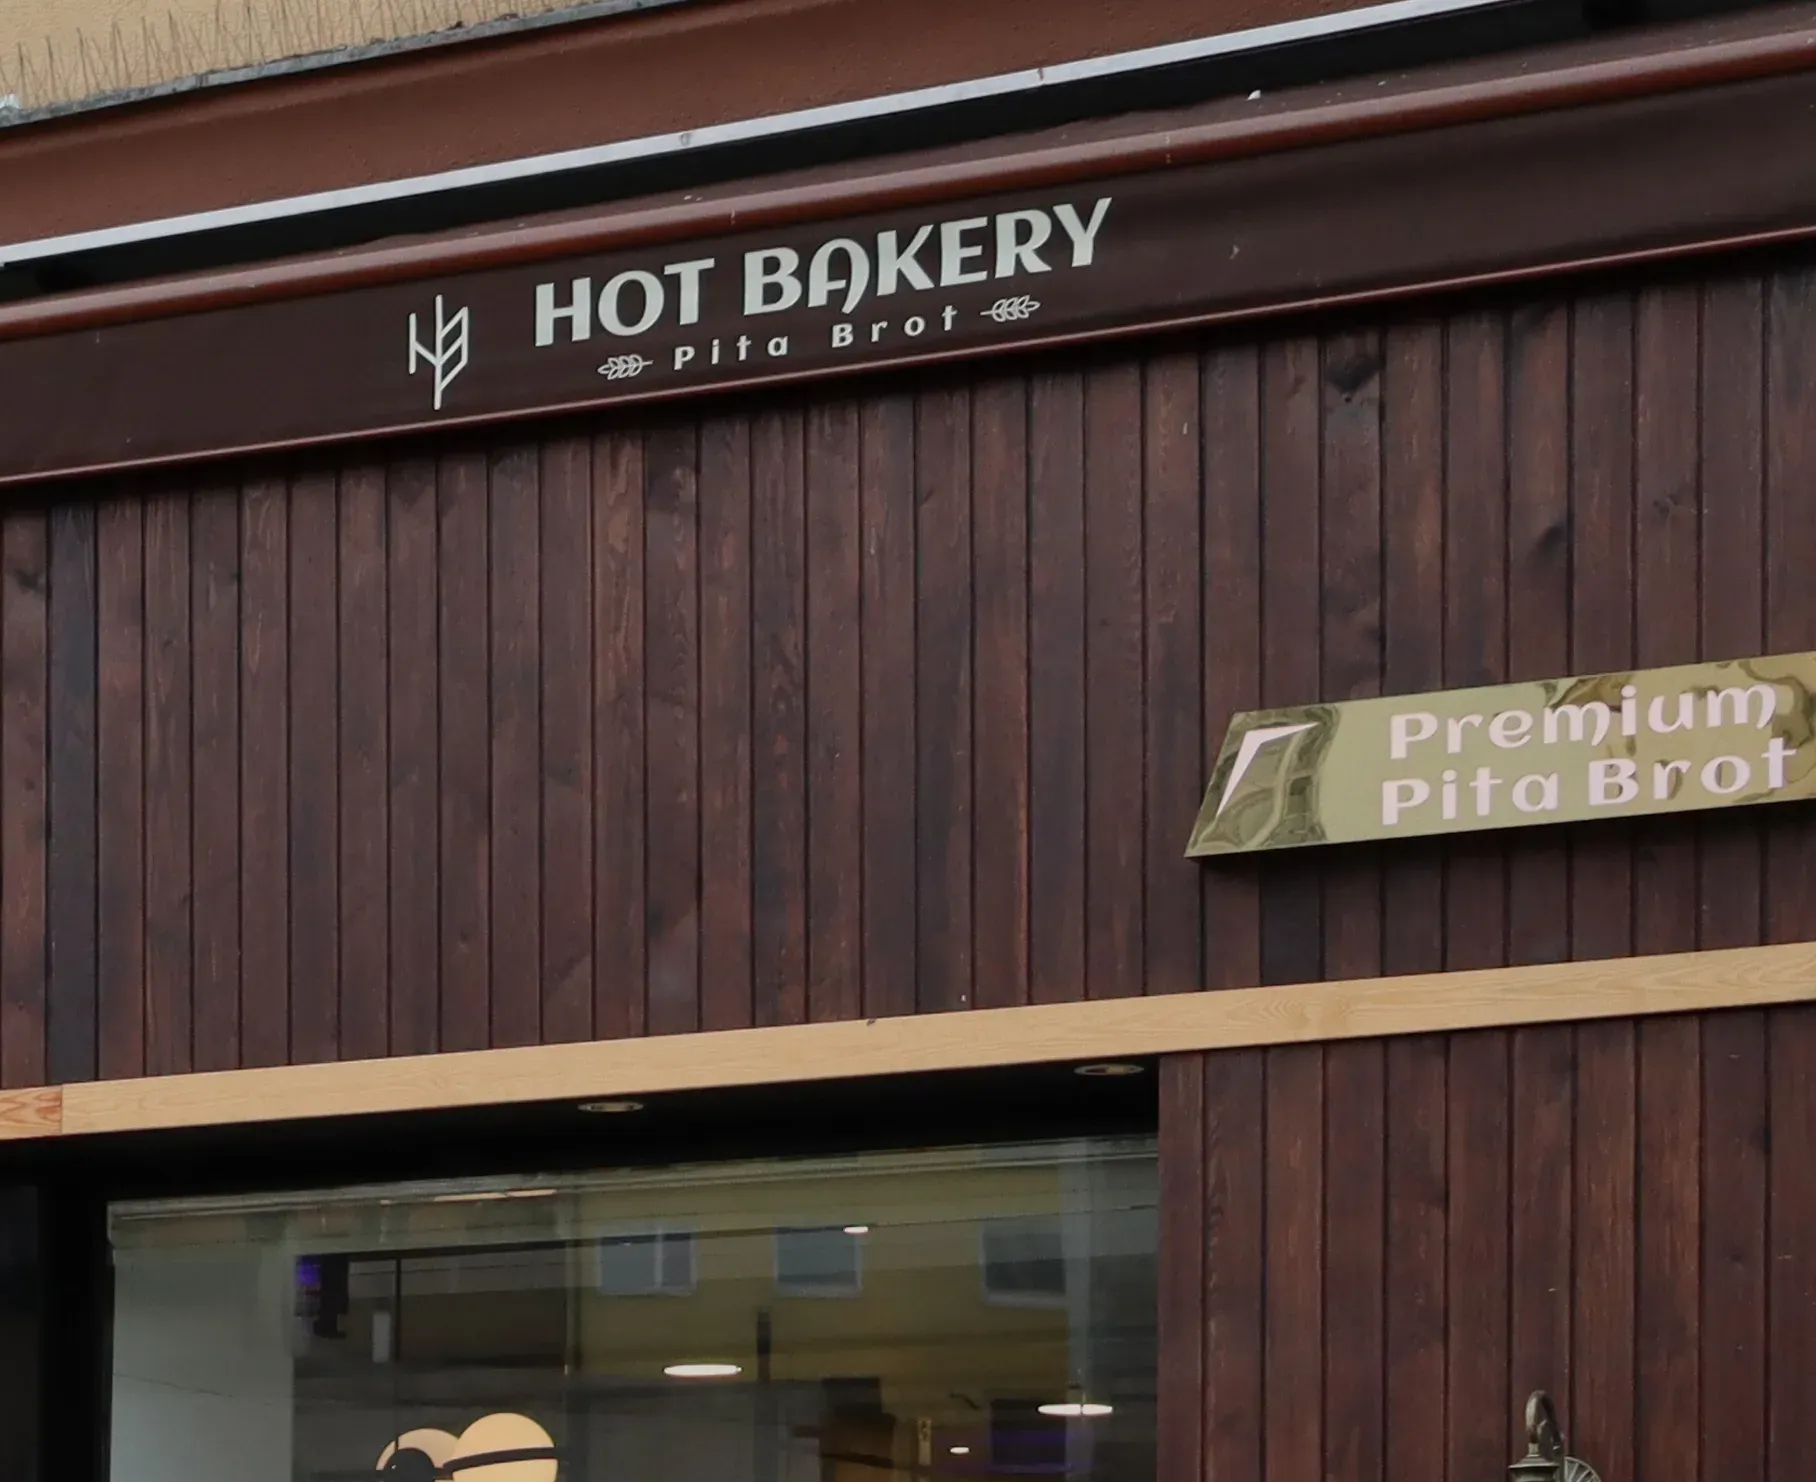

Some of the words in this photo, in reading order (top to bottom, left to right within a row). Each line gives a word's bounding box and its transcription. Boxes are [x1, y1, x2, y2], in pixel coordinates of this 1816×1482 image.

[534, 257, 716, 348] HOT
[742, 196, 1113, 315] BAKERY
[673, 333, 789, 371] Pita
[831, 304, 958, 349] Brot
[1389, 682, 1778, 760] Premium
[1380, 765, 1559, 827] Pita
[1587, 736, 1798, 807] Brot
